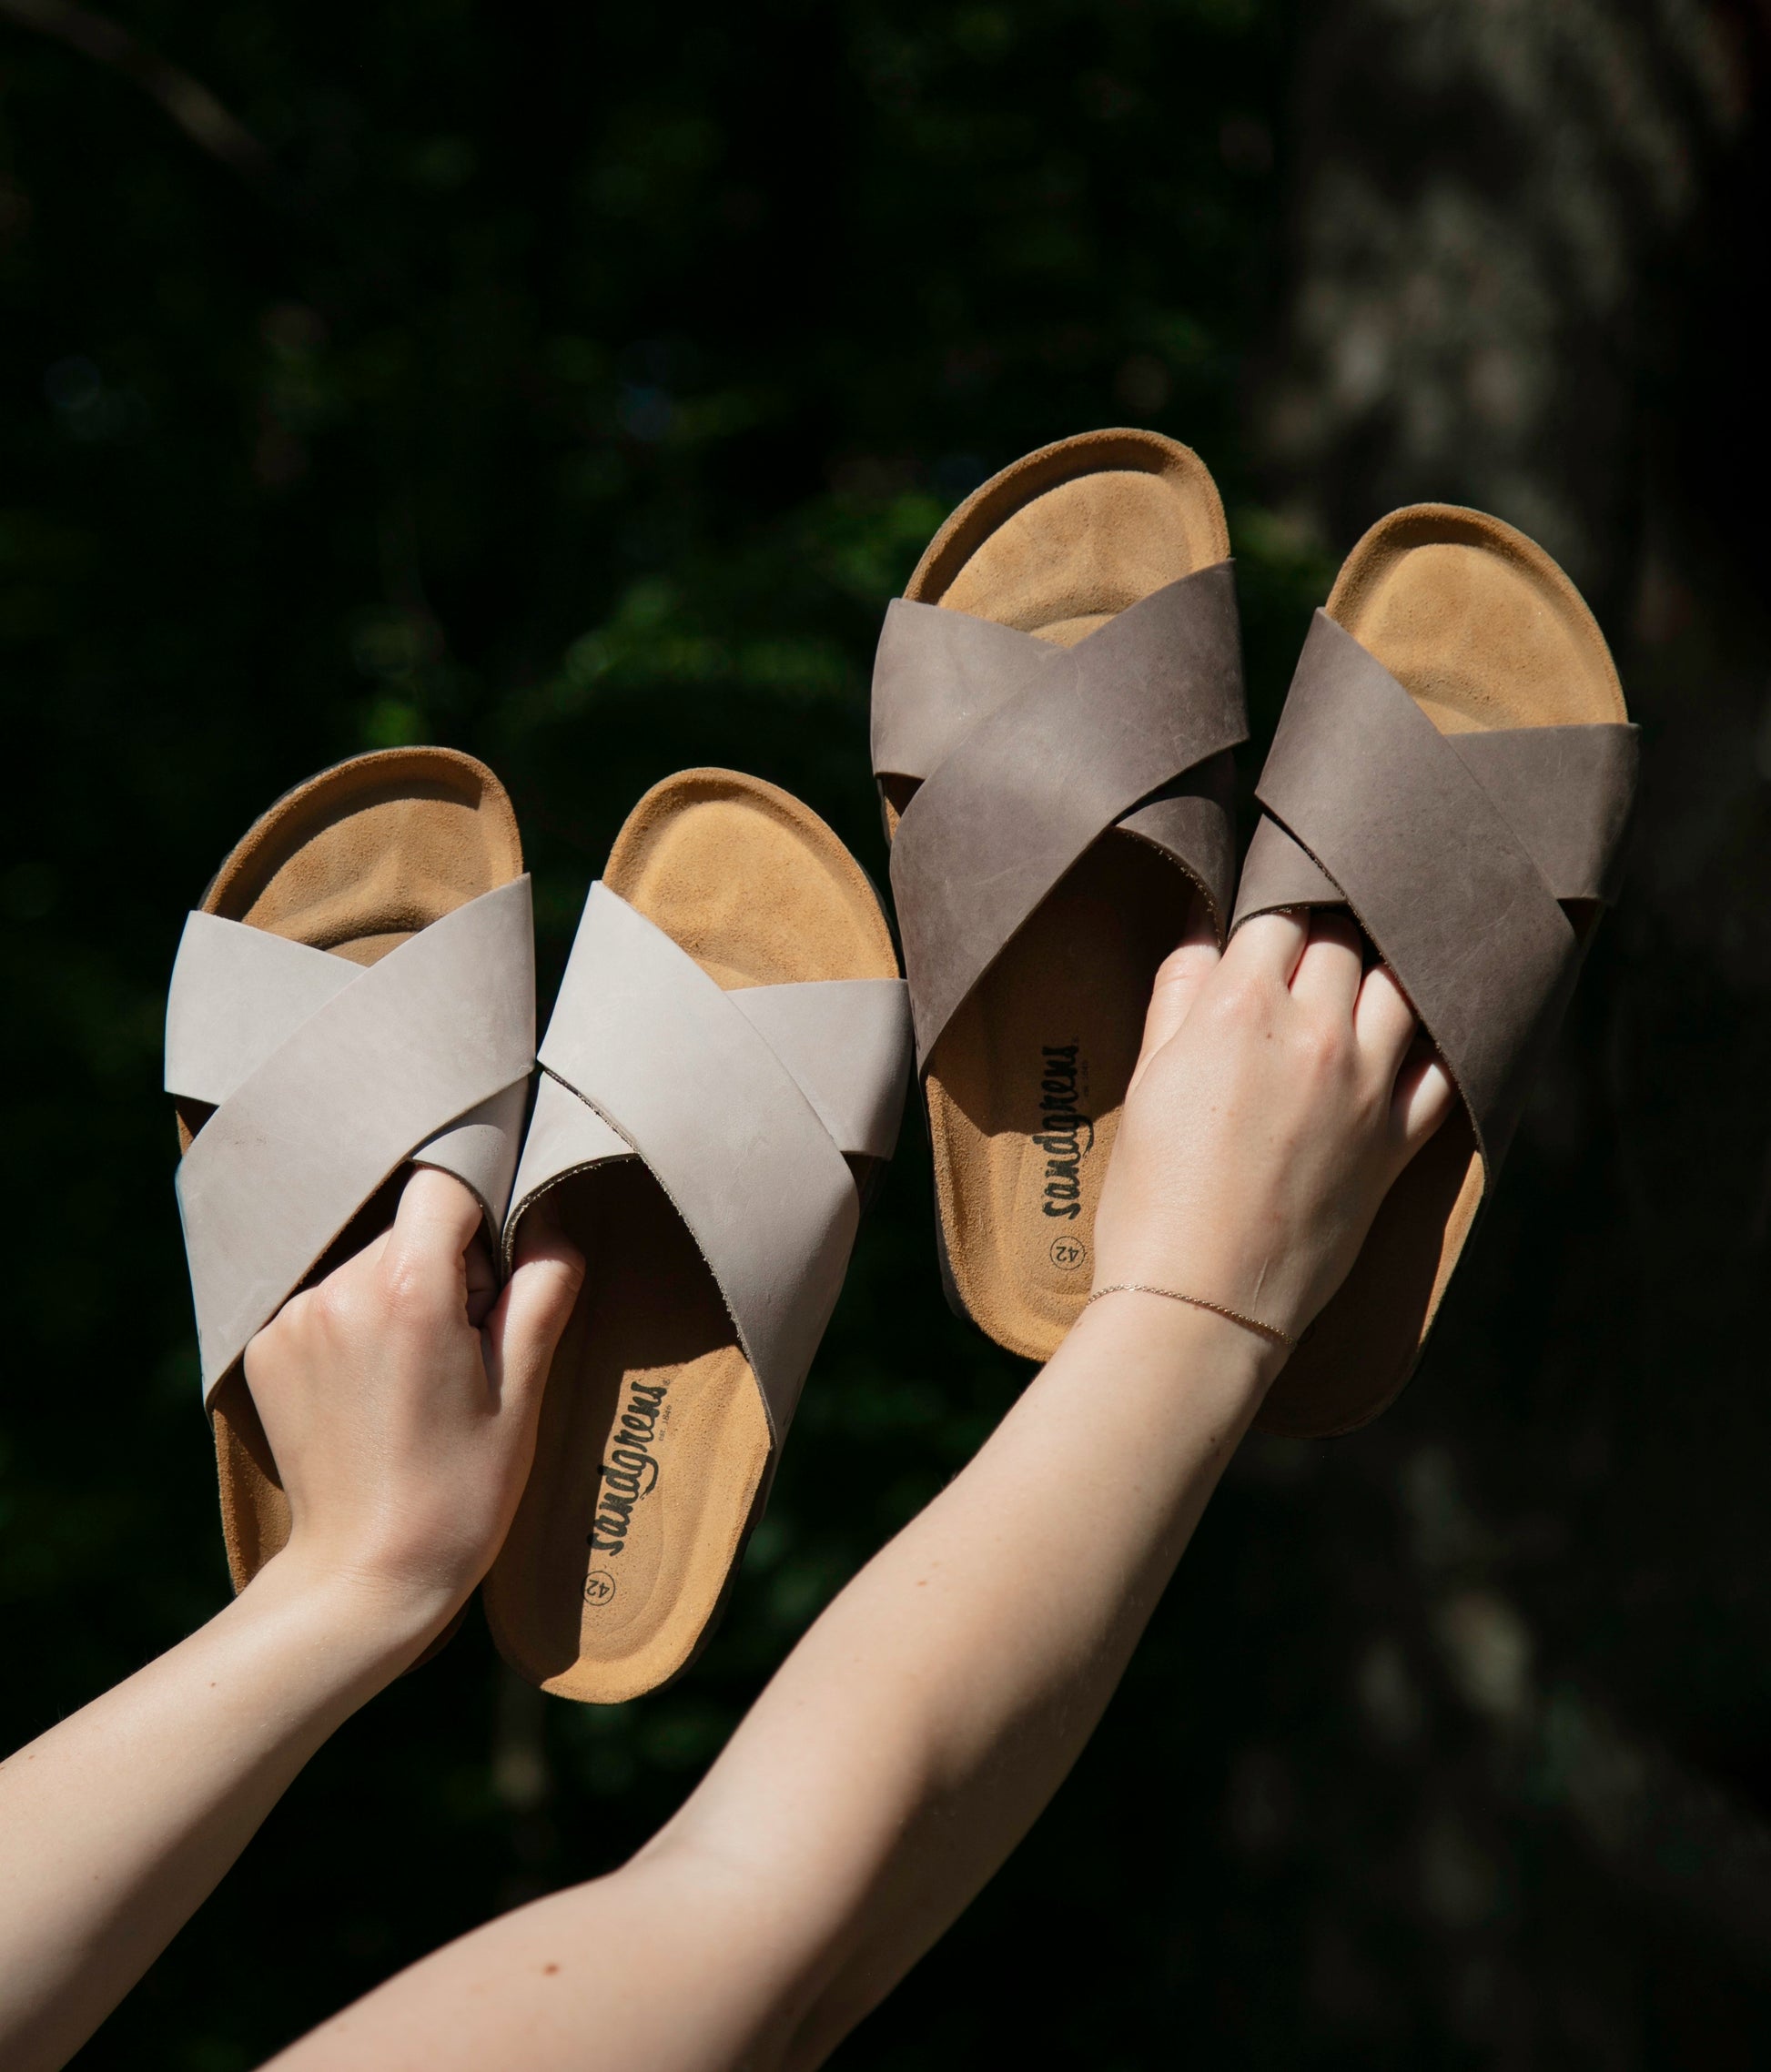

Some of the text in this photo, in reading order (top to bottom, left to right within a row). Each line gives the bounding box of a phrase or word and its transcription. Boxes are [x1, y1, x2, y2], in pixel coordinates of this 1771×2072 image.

[1032, 1046, 1095, 1220] sandgrens
[1056, 1245, 1079, 1263] 42
[586, 1380, 668, 1557] sandgrens
[585, 1579, 611, 1598] 42
